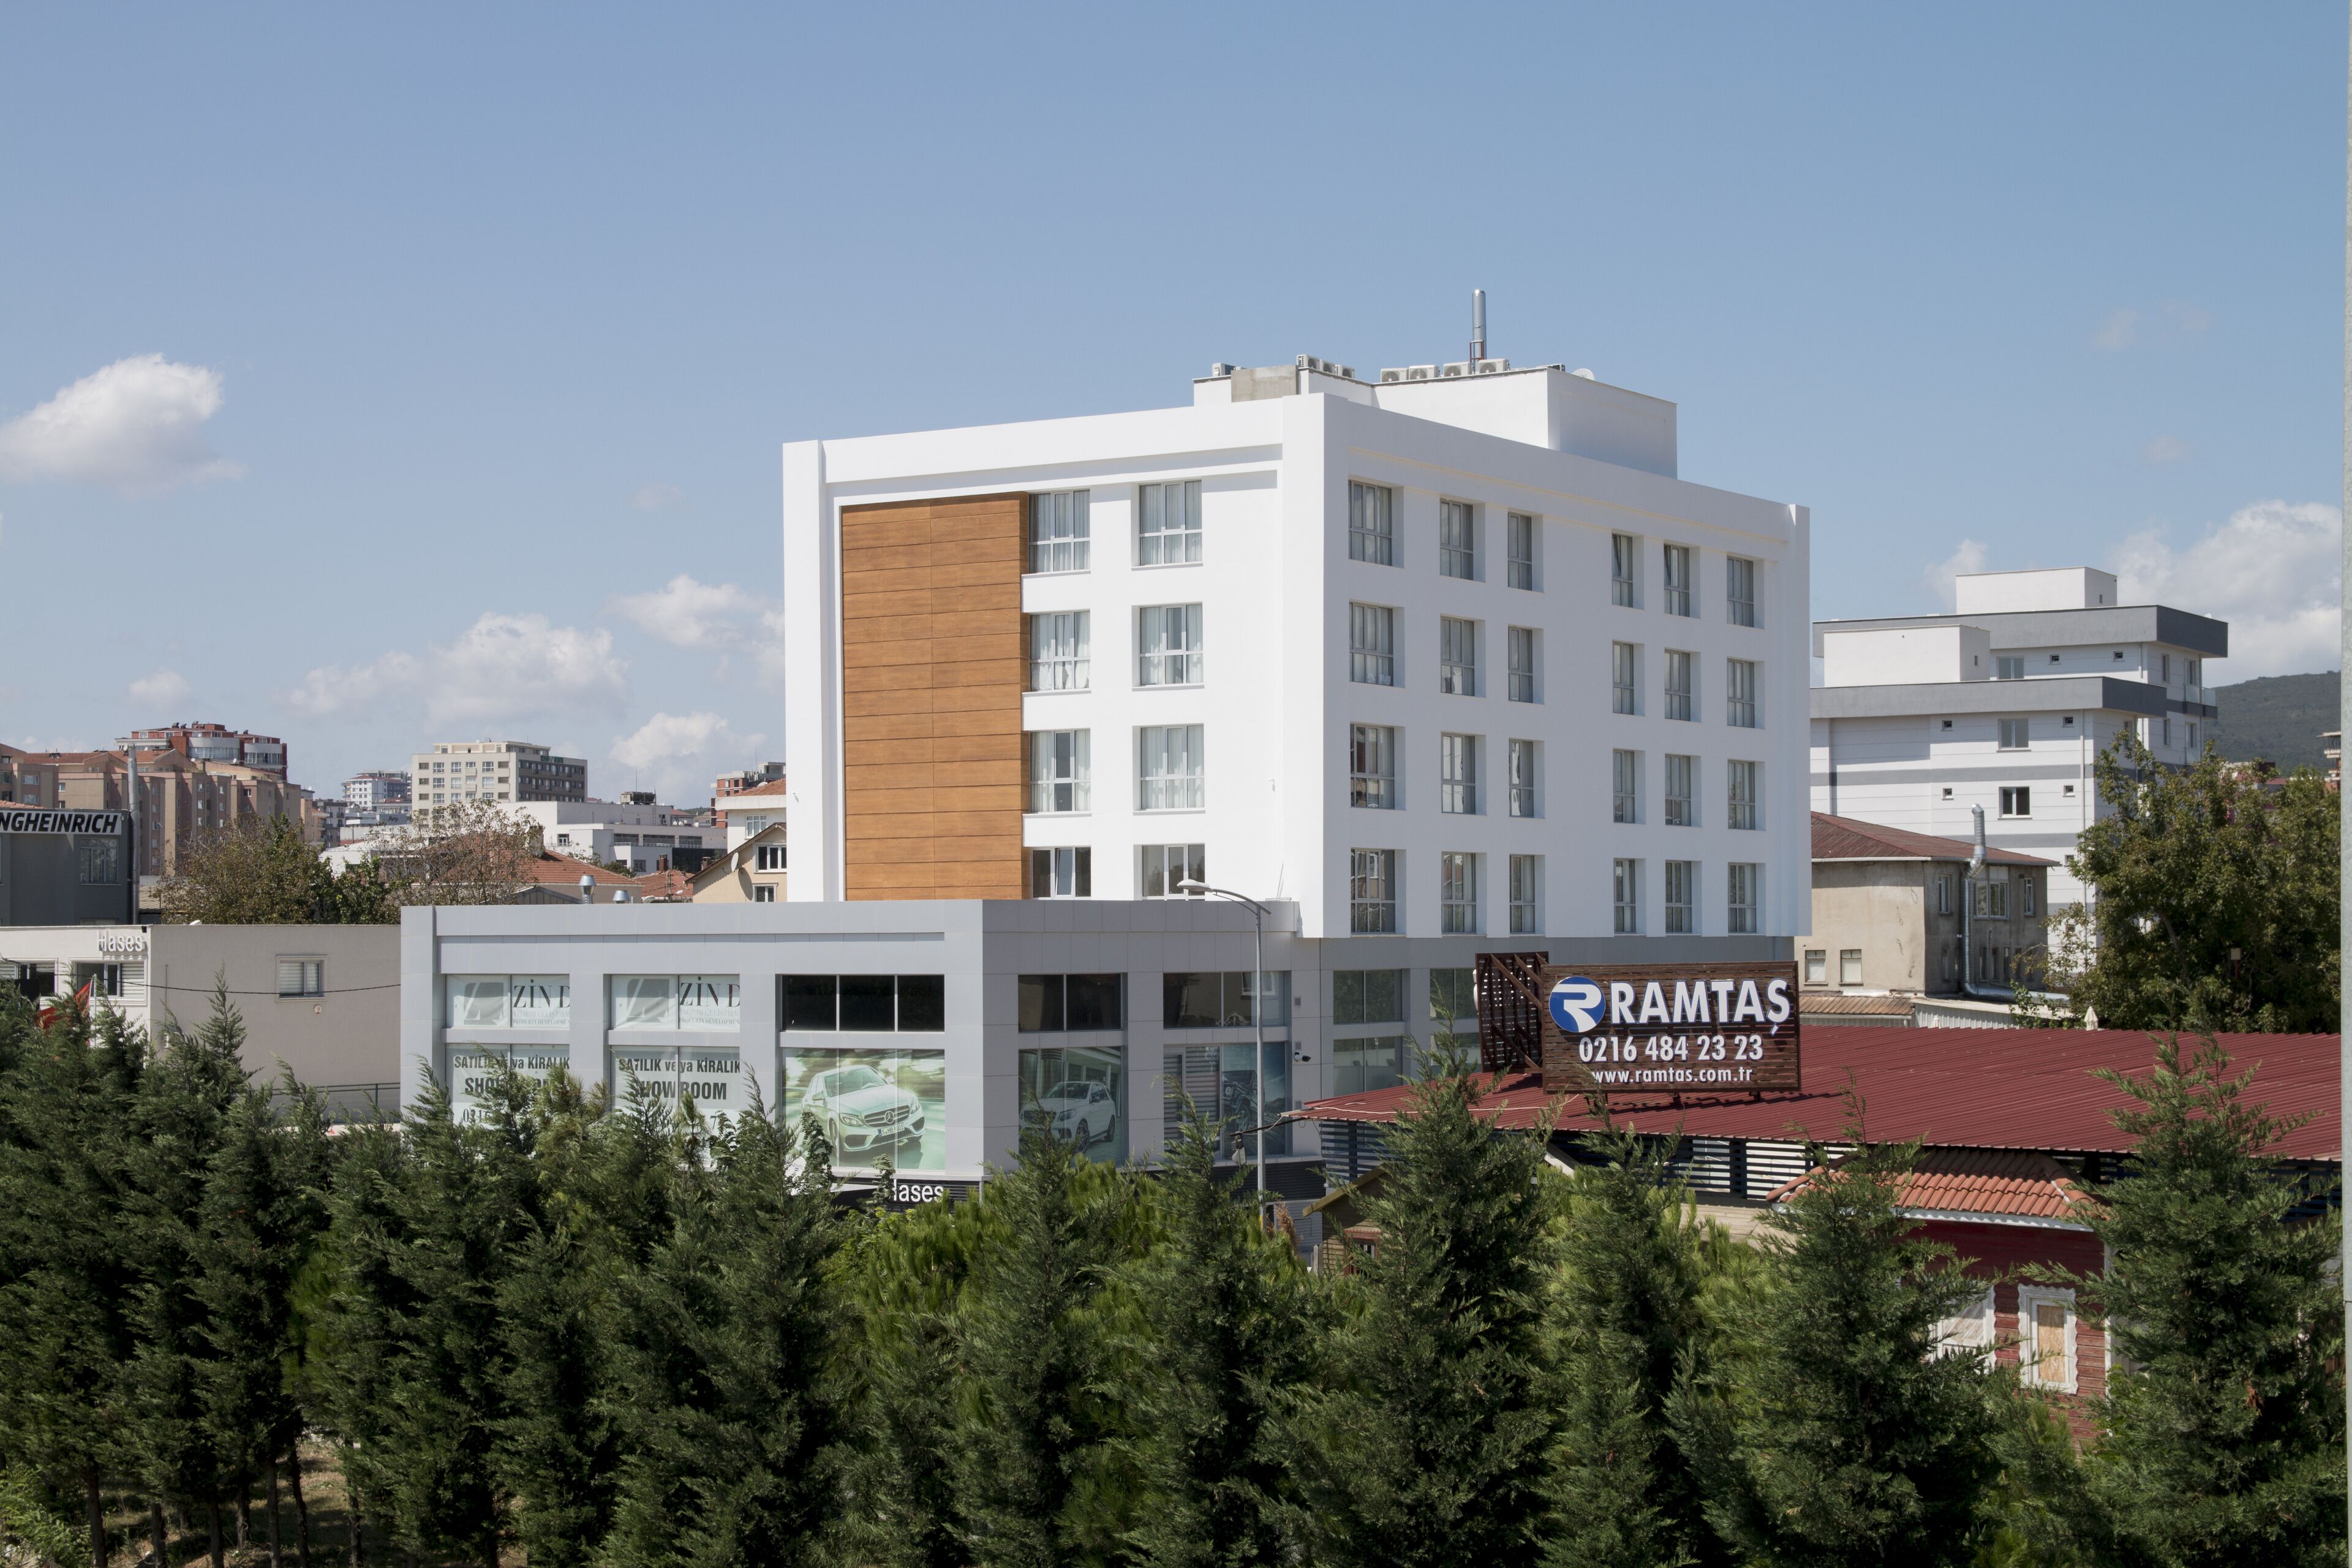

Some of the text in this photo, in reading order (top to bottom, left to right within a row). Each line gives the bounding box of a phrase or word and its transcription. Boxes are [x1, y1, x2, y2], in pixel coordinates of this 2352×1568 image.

[98, 930, 143, 952] Hases
[1610, 978, 1790, 1036] RAMTAŞ
[1578, 1034, 1763, 1063] 0216 484 23 23
[1592, 1066, 1753, 1083] www.ramtas.com.tr
[891, 1178, 944, 1202] ases
